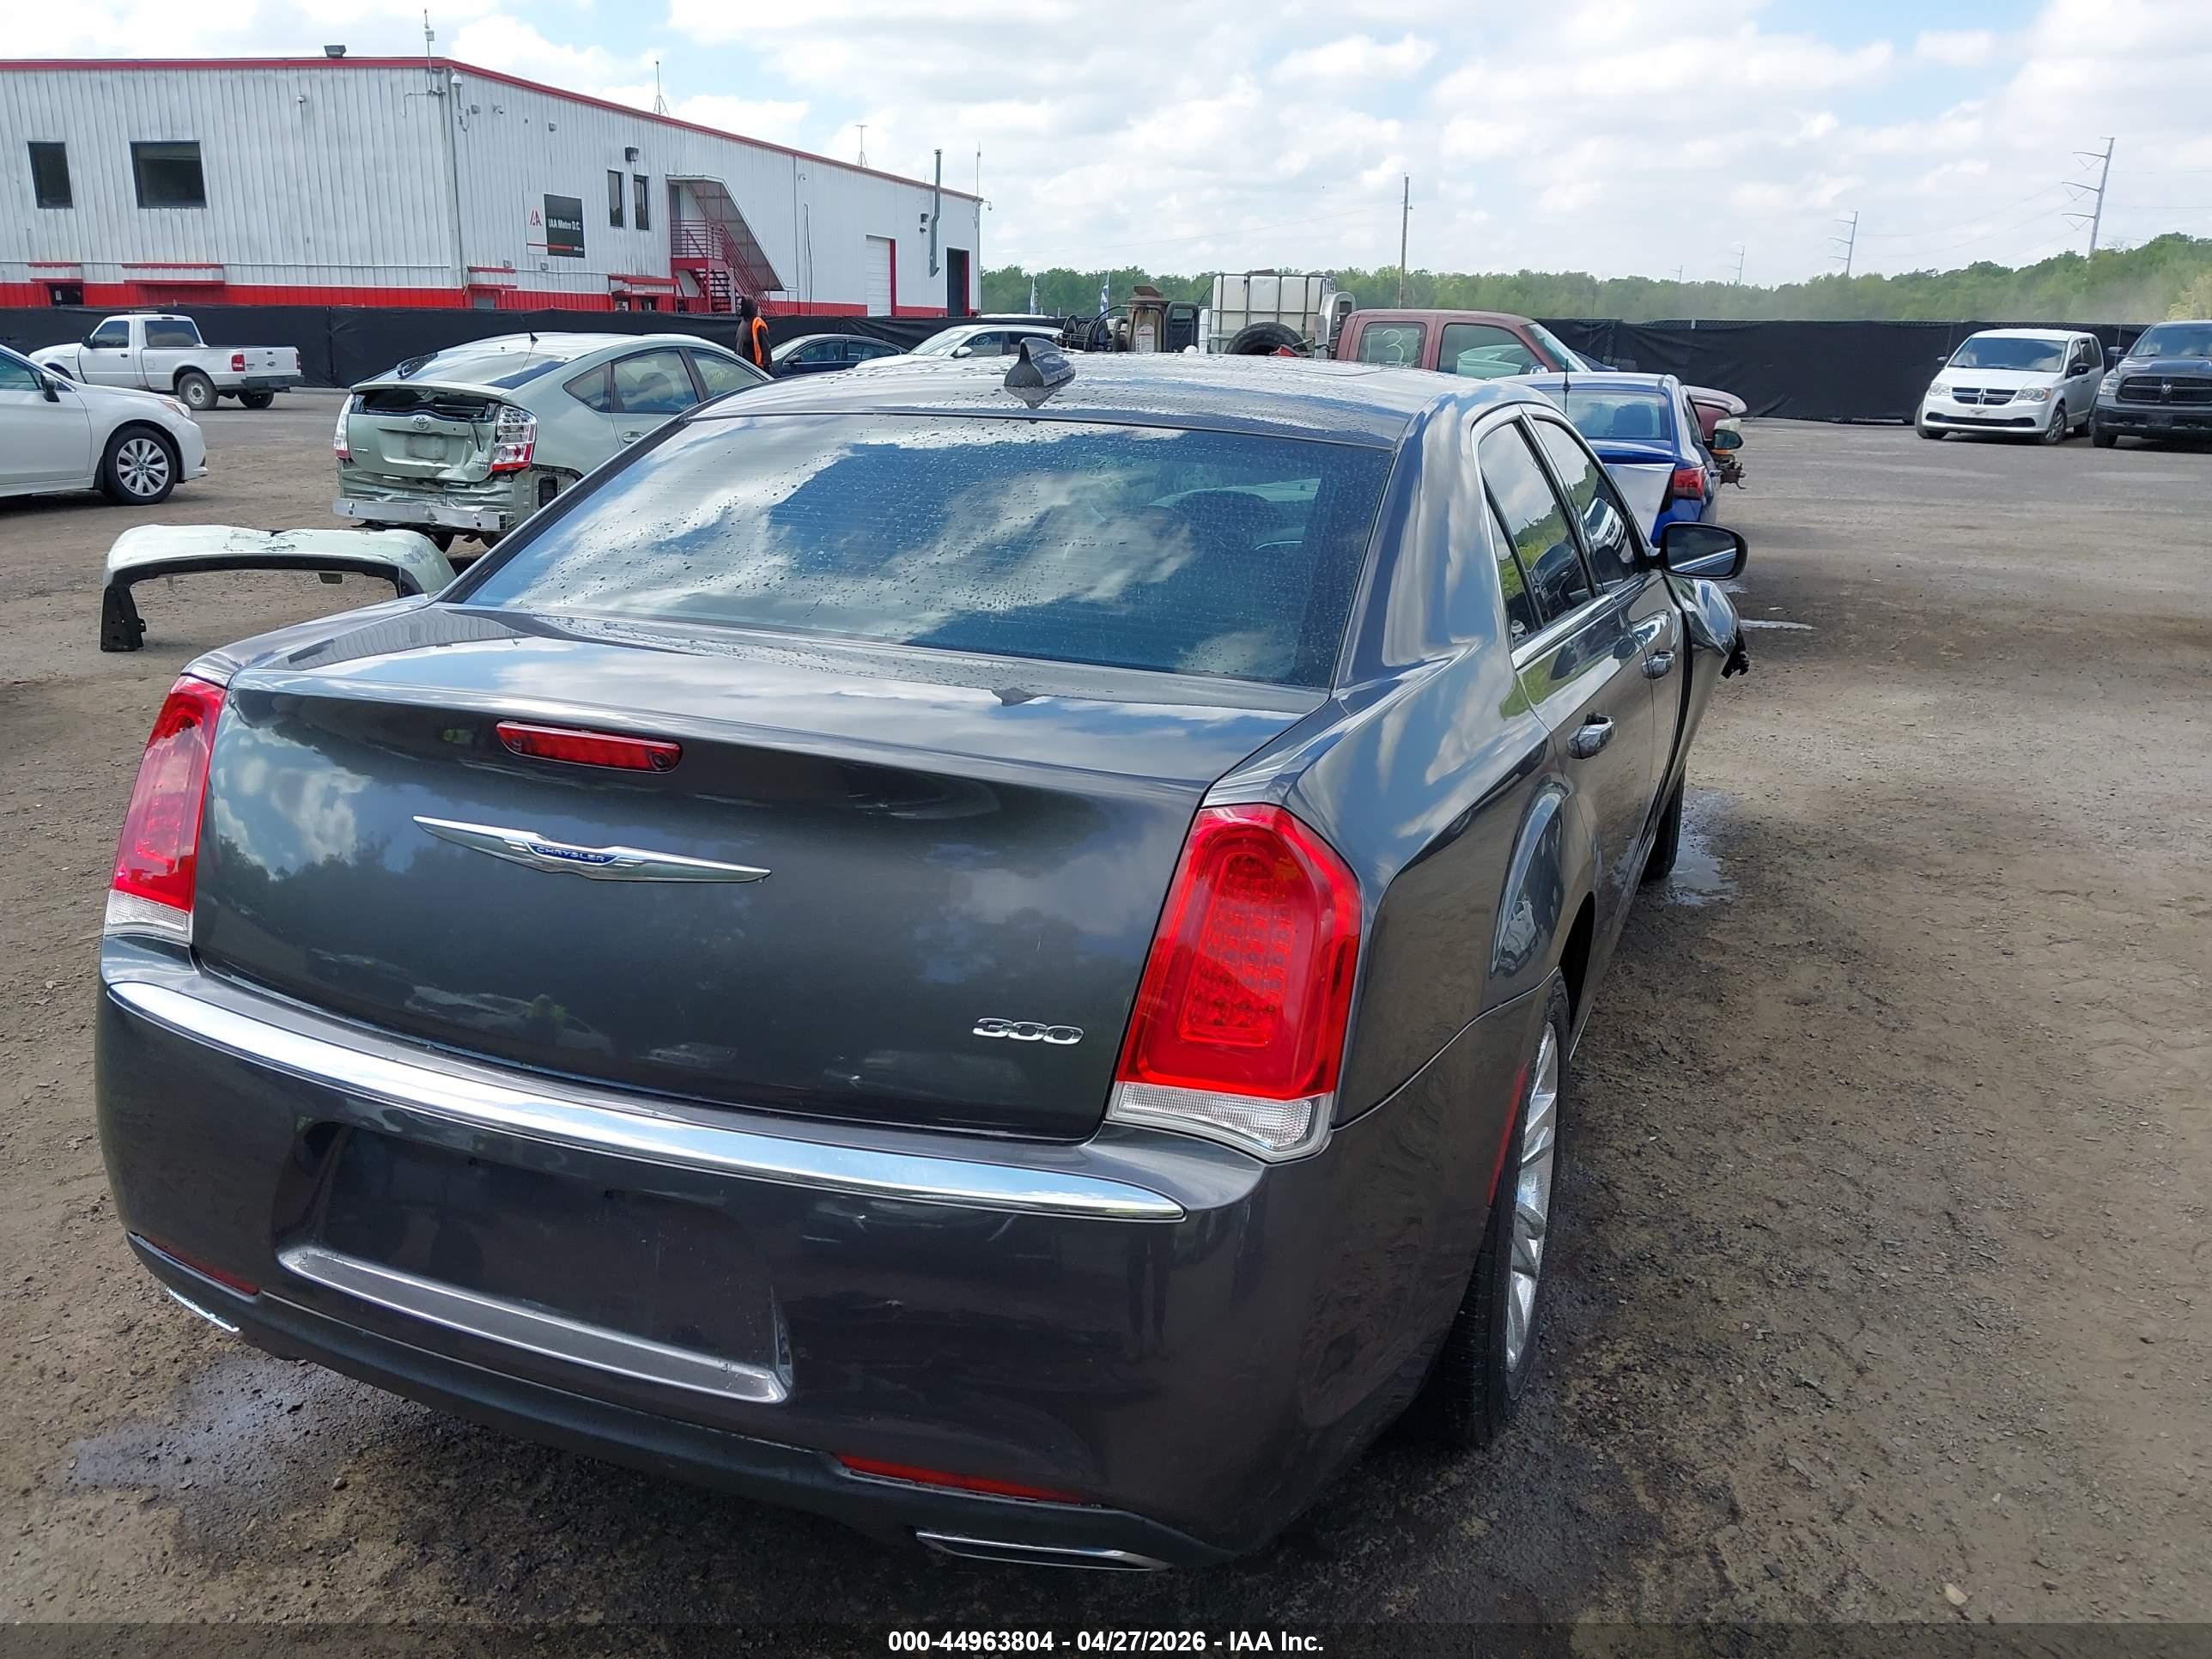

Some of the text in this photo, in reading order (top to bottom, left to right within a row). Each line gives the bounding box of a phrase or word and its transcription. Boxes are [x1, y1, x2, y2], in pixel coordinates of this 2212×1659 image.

[557, 219, 572, 230] Metro
[536, 847, 605, 861] CHRYSLER
[972, 1018, 1085, 1045] 300
